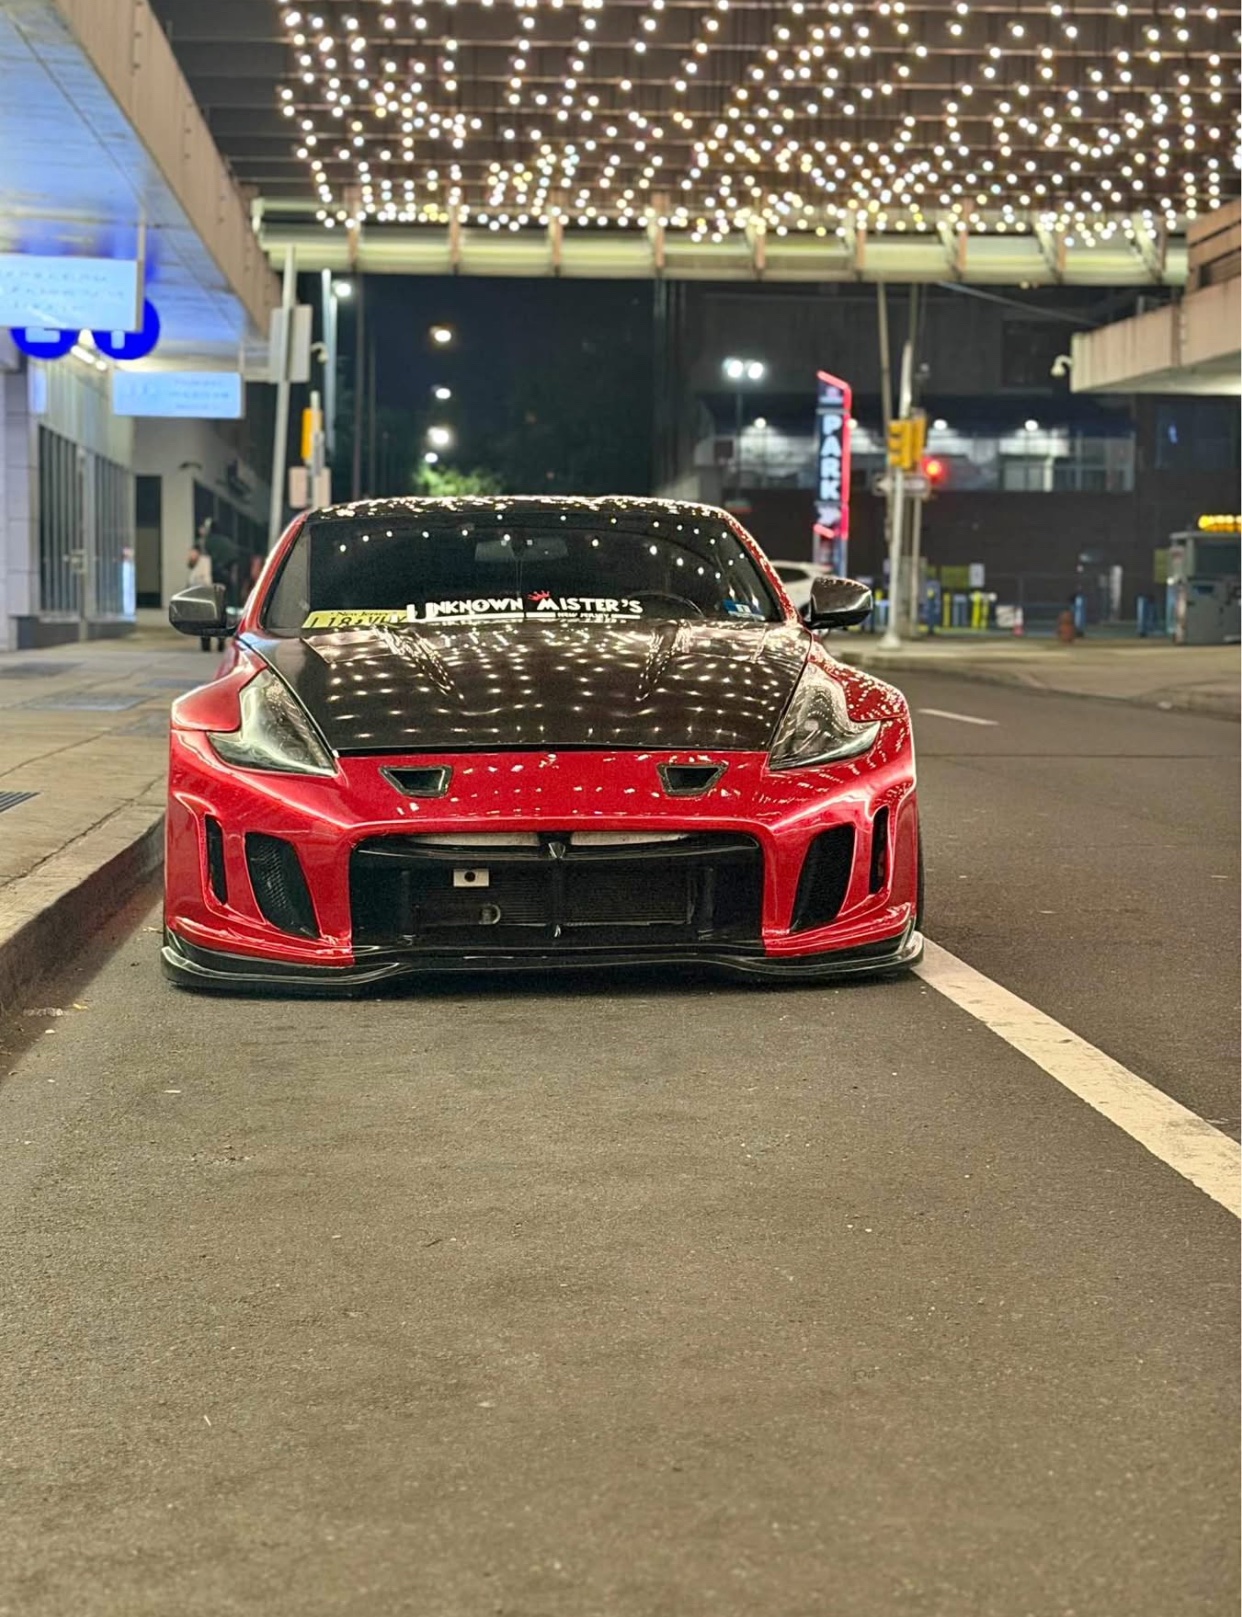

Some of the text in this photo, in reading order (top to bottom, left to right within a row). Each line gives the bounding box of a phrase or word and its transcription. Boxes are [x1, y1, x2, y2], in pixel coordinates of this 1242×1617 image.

[820, 414, 842, 500] PARK
[406, 597, 643, 623] UNKNOWN MISTER'S
